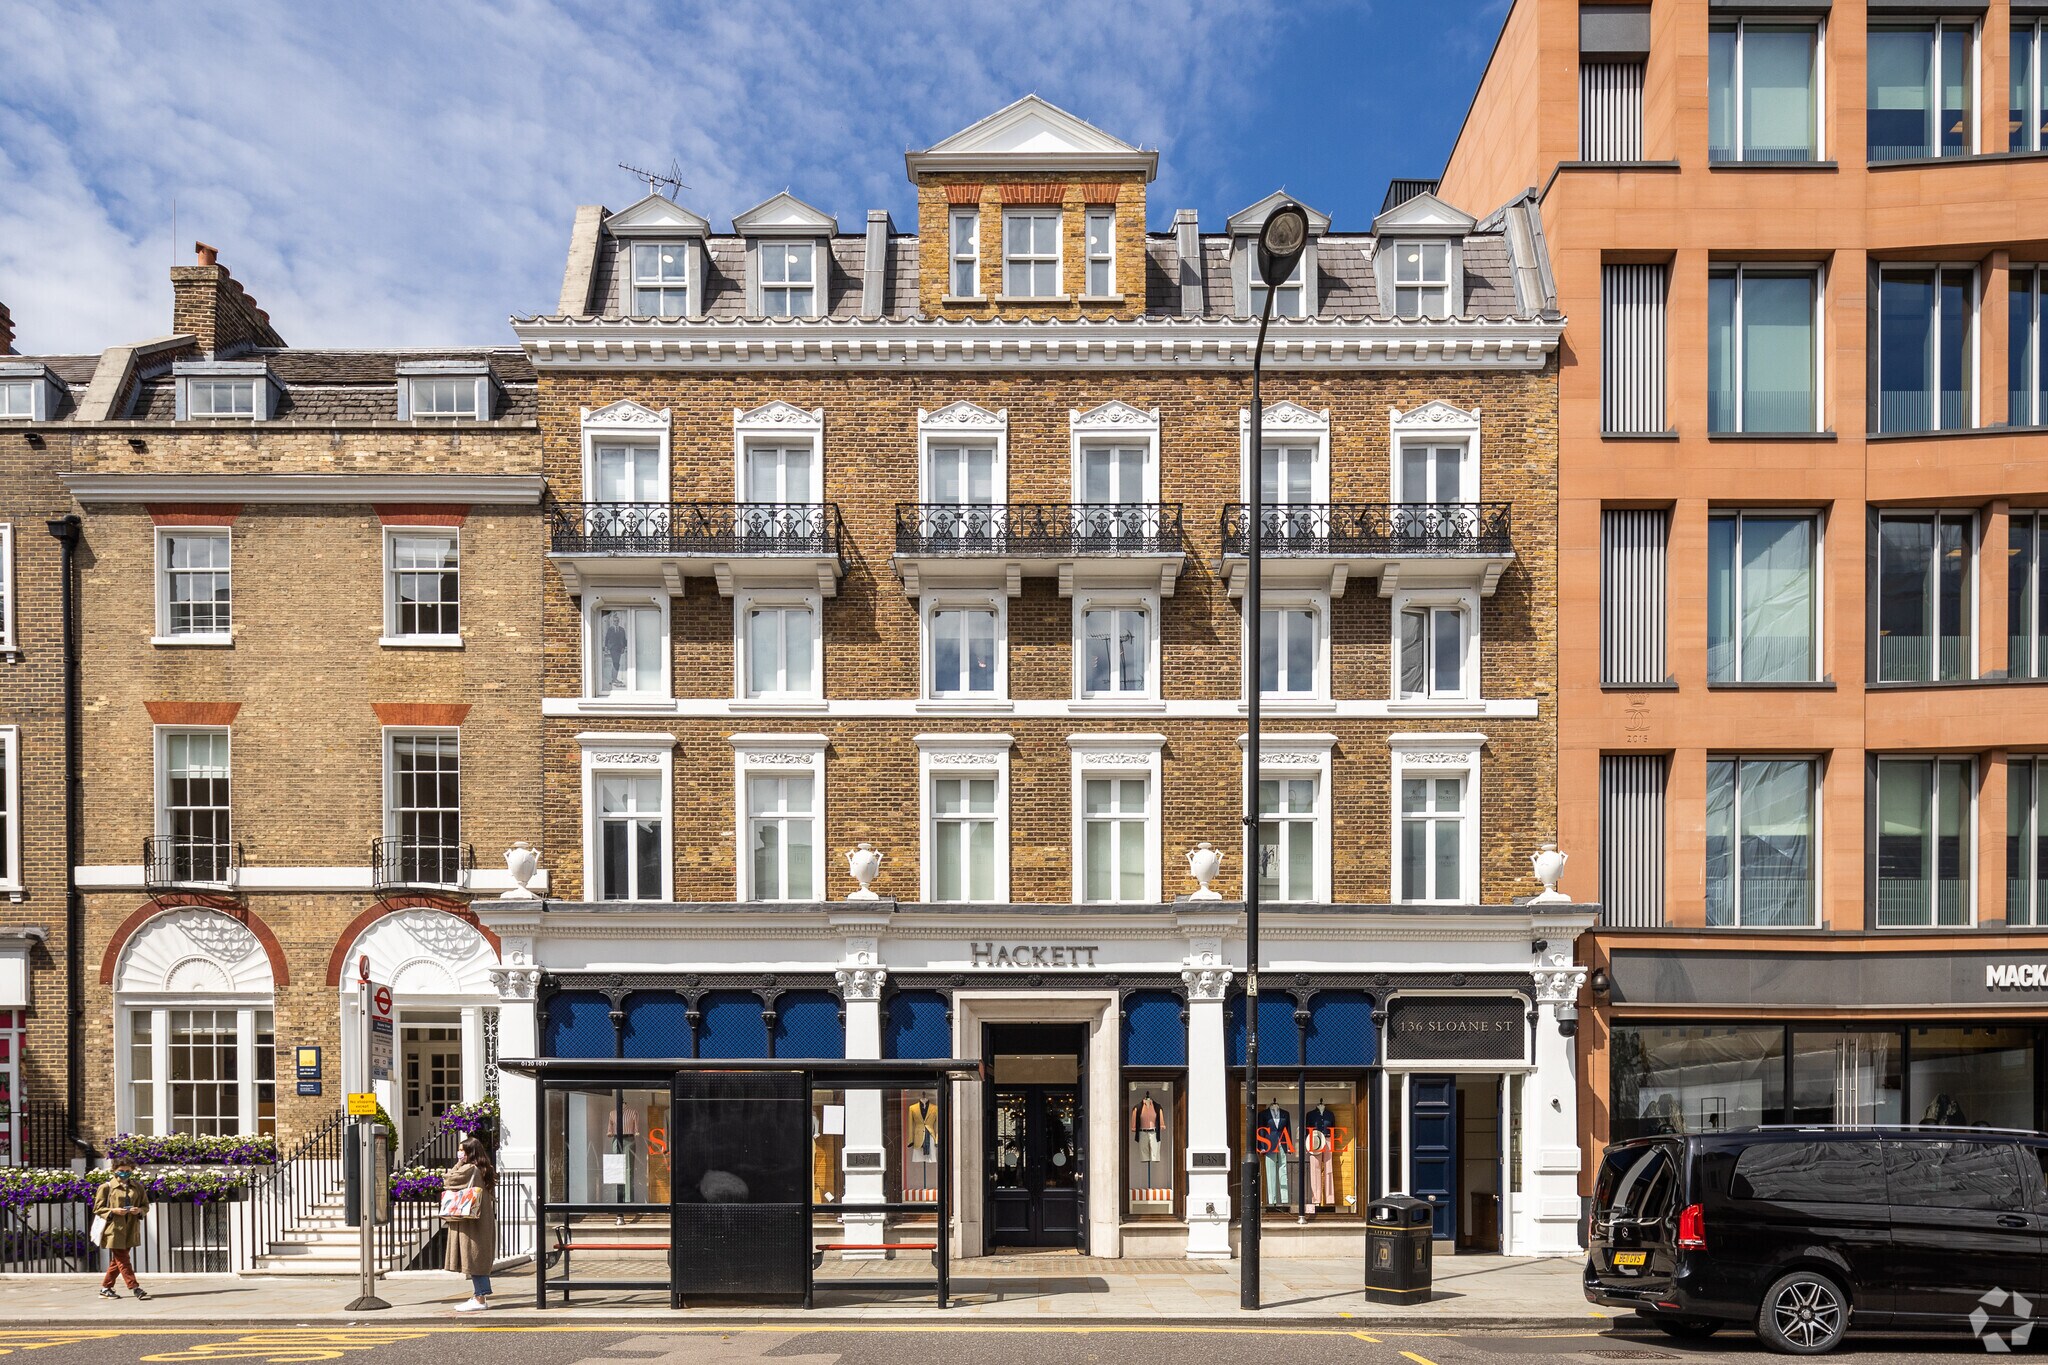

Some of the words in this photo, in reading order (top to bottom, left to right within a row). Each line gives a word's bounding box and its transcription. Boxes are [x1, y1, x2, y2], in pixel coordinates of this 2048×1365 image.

[970, 942, 1099, 968] HACKETT
[1986, 964, 2048, 987] MACK
[1400, 1022, 1423, 1032] 136
[1428, 1022, 1489, 1032] SLOANE
[1495, 1021, 1513, 1032] ST
